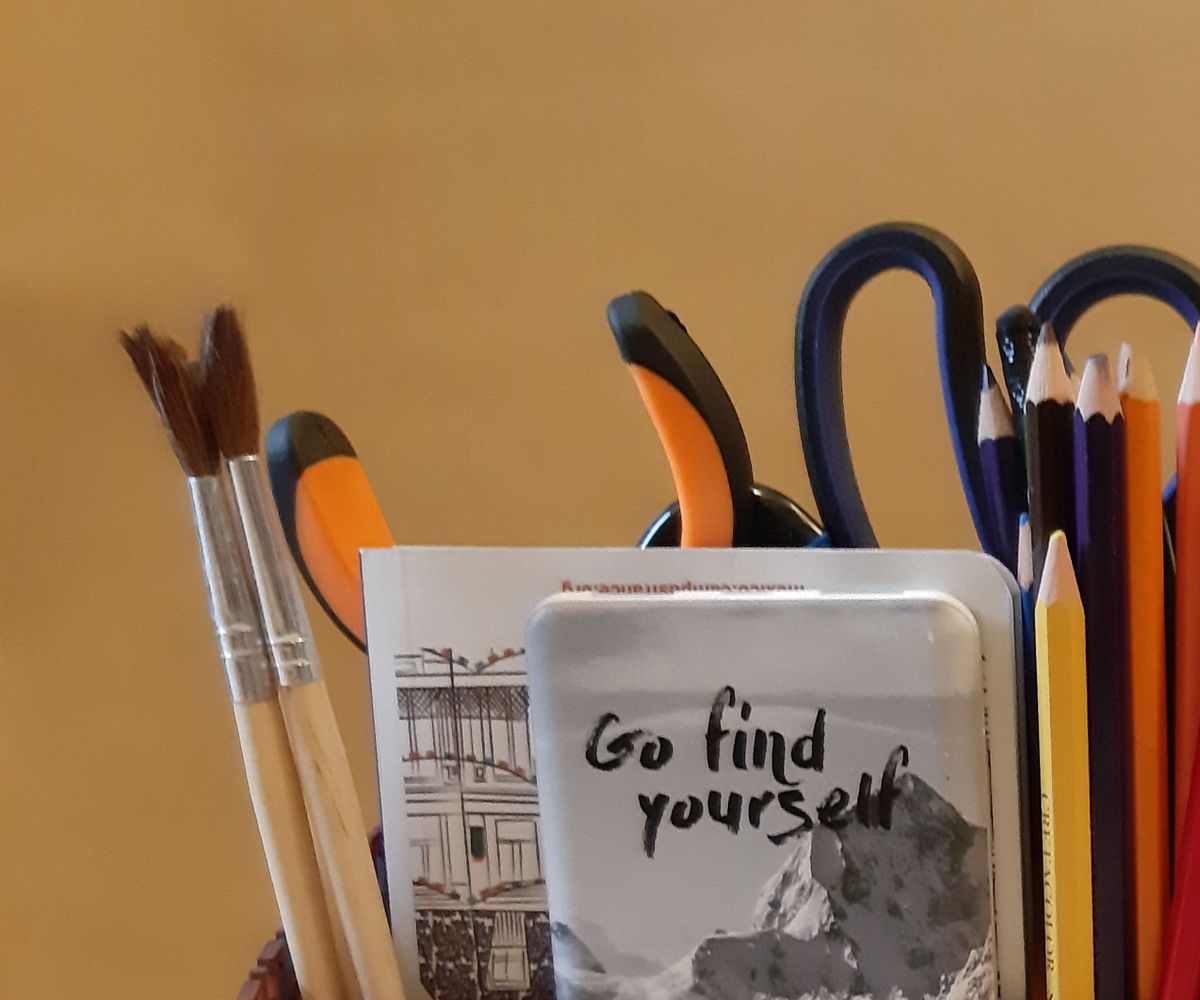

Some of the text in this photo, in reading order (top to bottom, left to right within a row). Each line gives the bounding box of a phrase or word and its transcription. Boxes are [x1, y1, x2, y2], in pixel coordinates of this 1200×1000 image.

[584, 685, 827, 786] Go find
[637, 745, 909, 859] yourself
